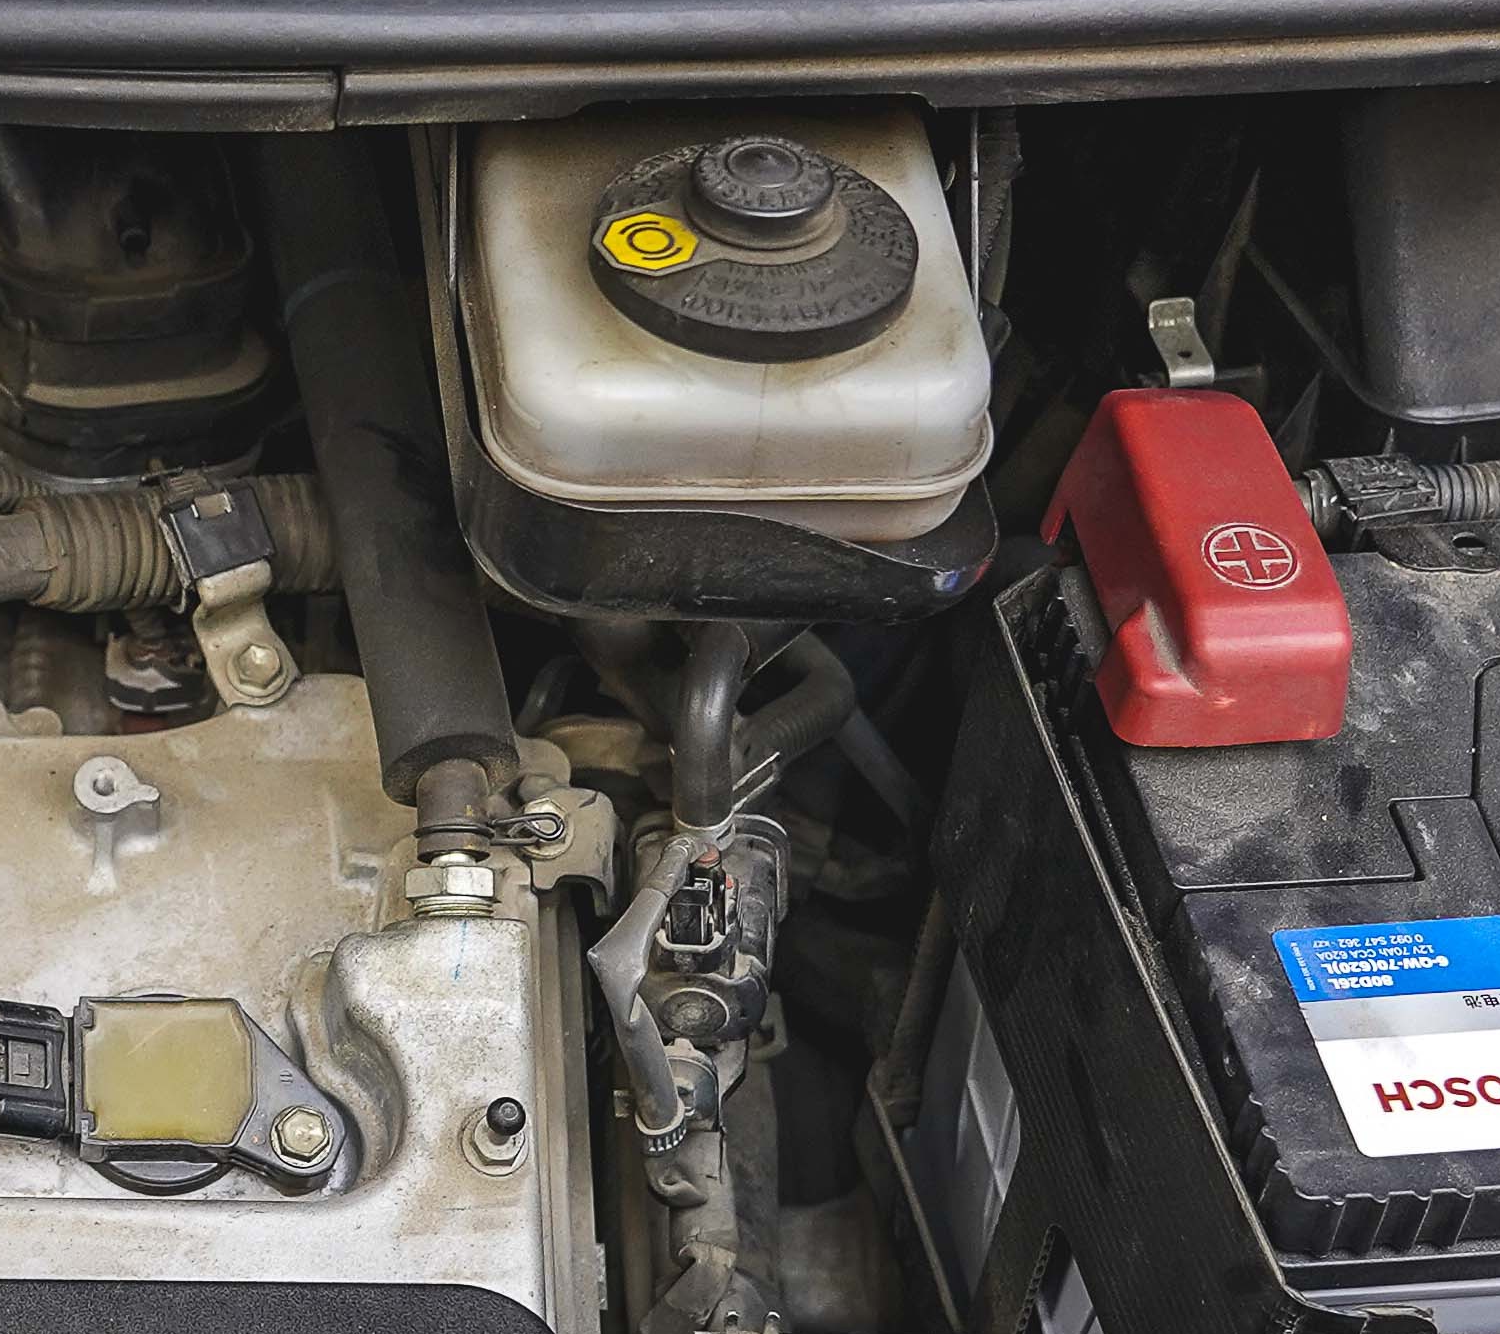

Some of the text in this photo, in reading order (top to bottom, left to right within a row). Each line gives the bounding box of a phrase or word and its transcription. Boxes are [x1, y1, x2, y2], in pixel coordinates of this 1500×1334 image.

[1389, 935, 1412, 945] 092
[1315, 944, 1434, 961] 12V 70Ah CCA 620A
[1321, 955, 1449, 975] 6-QW-70(620)L
[1327, 974, 1394, 990] 80D26L
